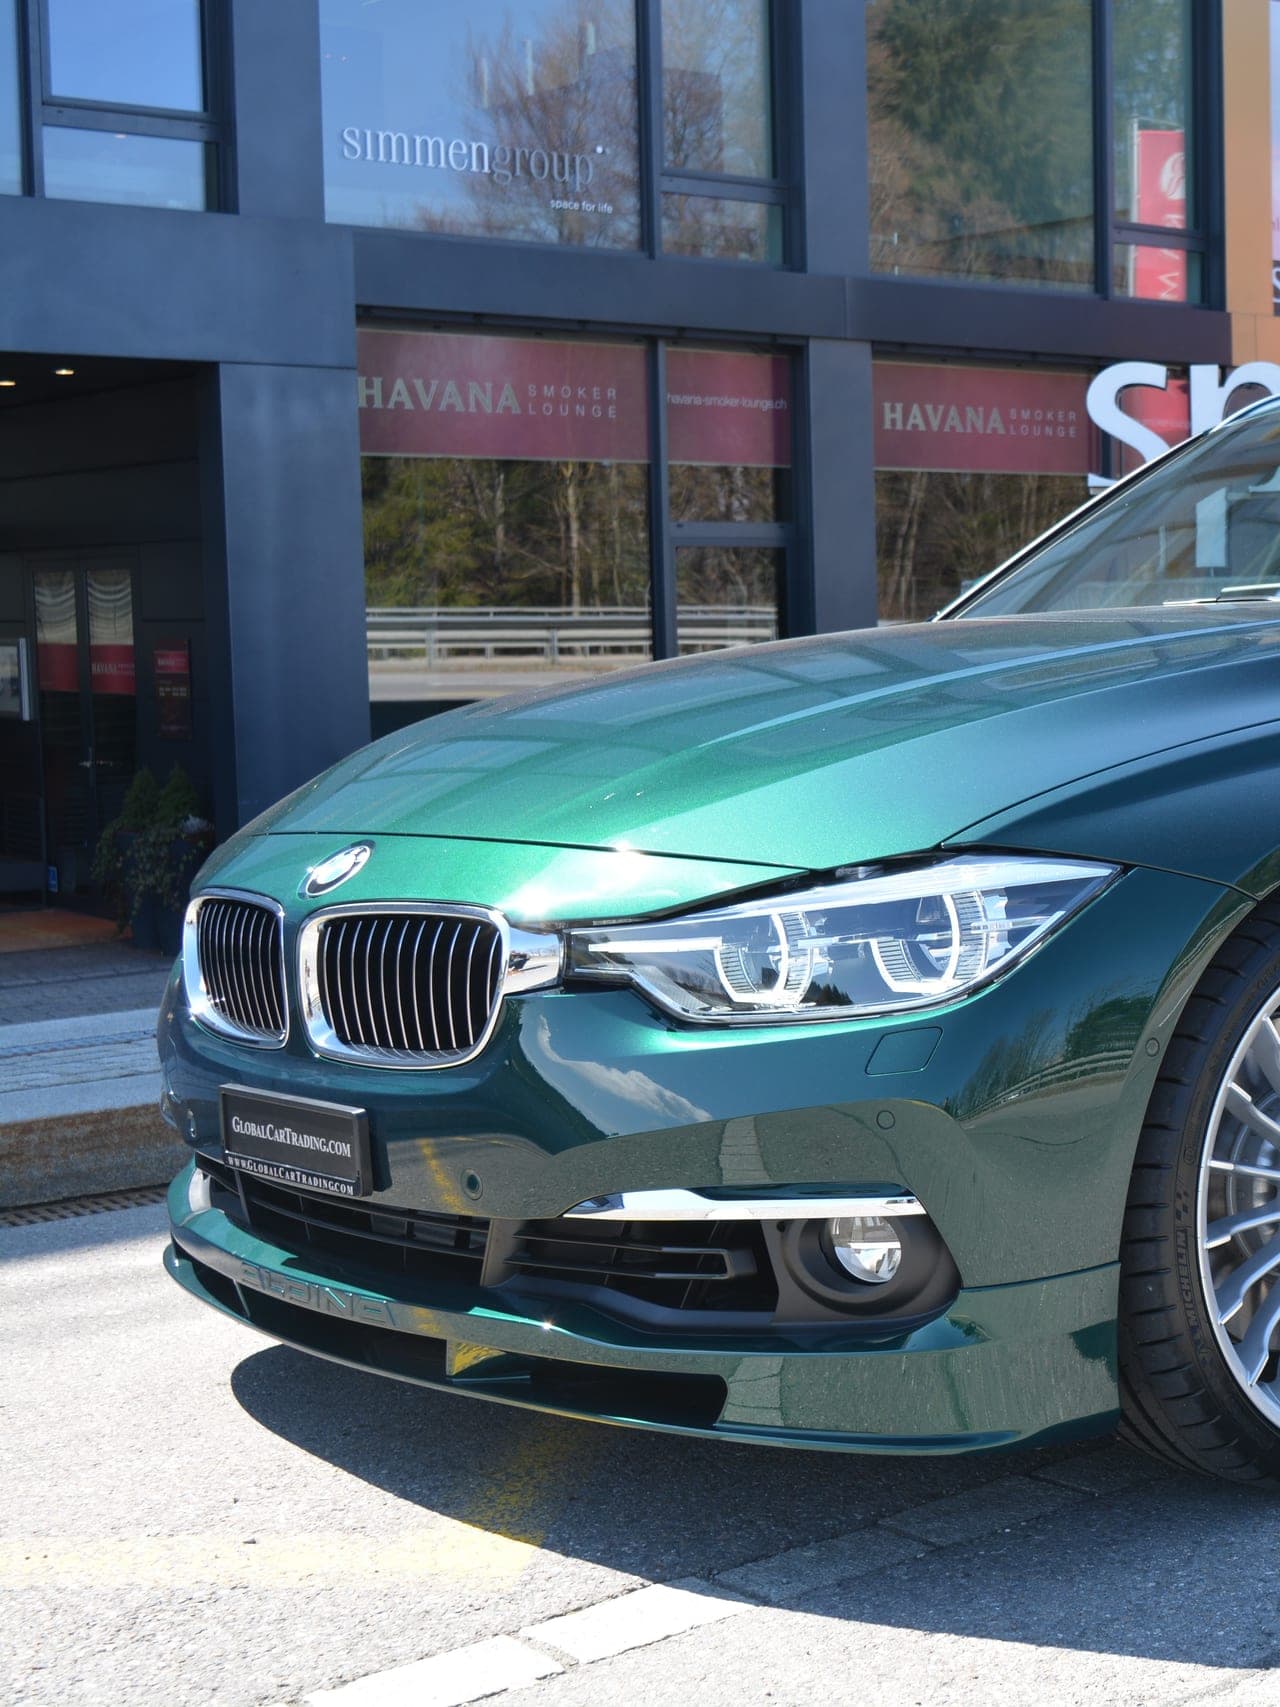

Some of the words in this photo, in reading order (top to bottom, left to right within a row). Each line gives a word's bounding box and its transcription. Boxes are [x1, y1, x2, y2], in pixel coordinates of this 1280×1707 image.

[342, 127, 595, 192] simmengroup
[550, 200, 579, 213] space
[582, 200, 596, 212] for
[598, 201, 613, 214] life
[357, 376, 522, 415] HAVANA
[528, 384, 617, 399] SMOKER
[528, 402, 617, 418] LOUNGE
[882, 402, 1005, 434] HAVANA
[1009, 408, 1076, 422] SMOKER
[1010, 426, 1076, 438] LOUNGE
[1176, 1229, 1202, 1329] MICHELIN
